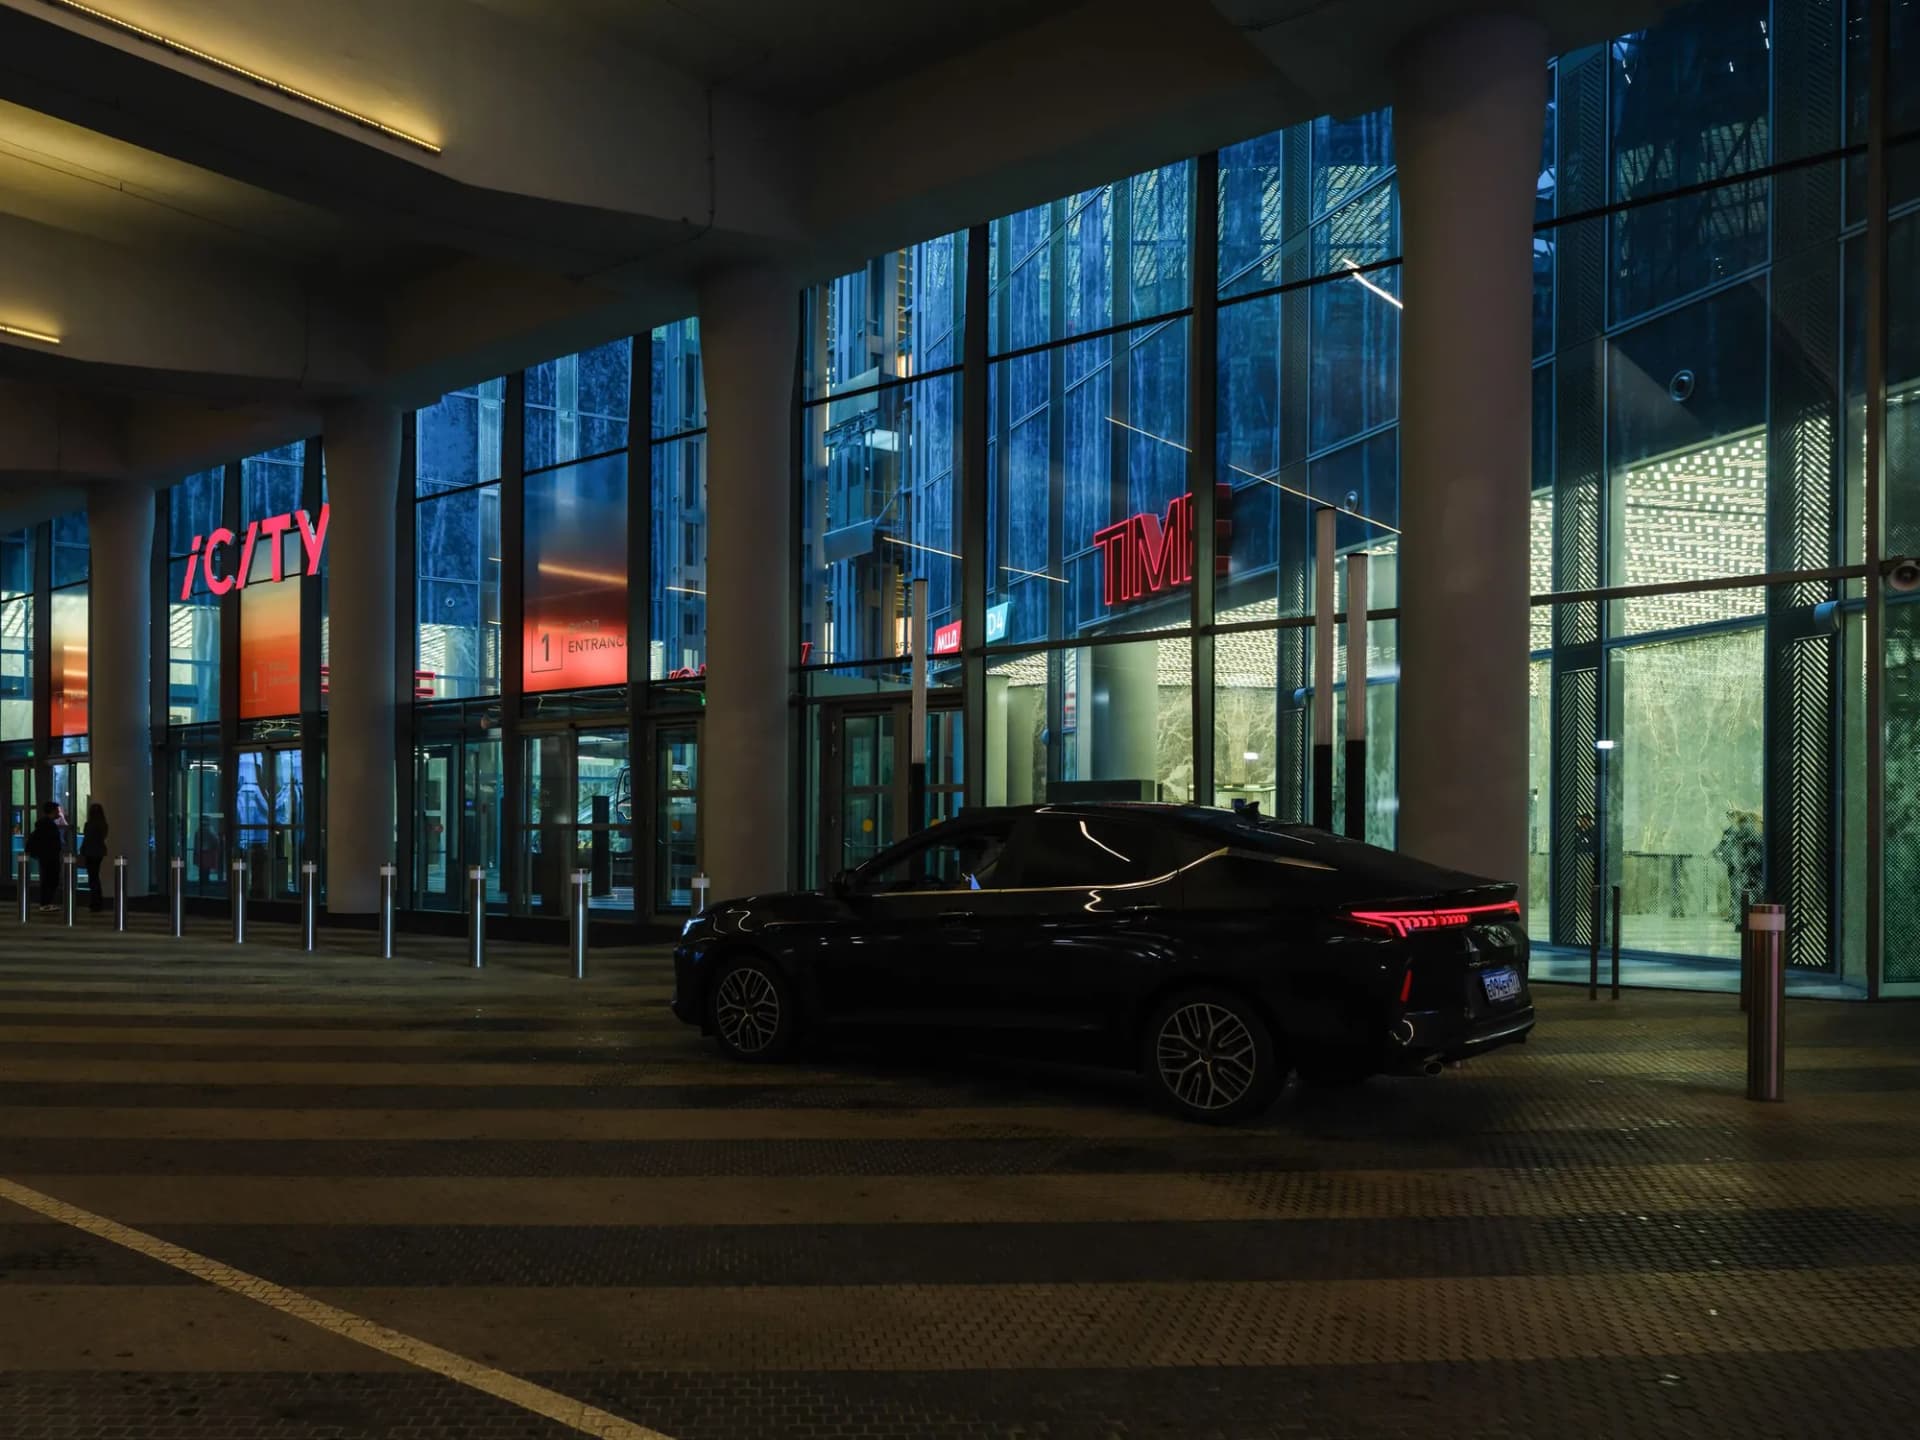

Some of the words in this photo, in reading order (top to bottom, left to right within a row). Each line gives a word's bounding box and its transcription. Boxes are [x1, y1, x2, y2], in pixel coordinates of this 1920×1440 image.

[988, 610, 1004, 636] D4
[541, 632, 550, 662] 1
[567, 635, 628, 654] ENTRANC
